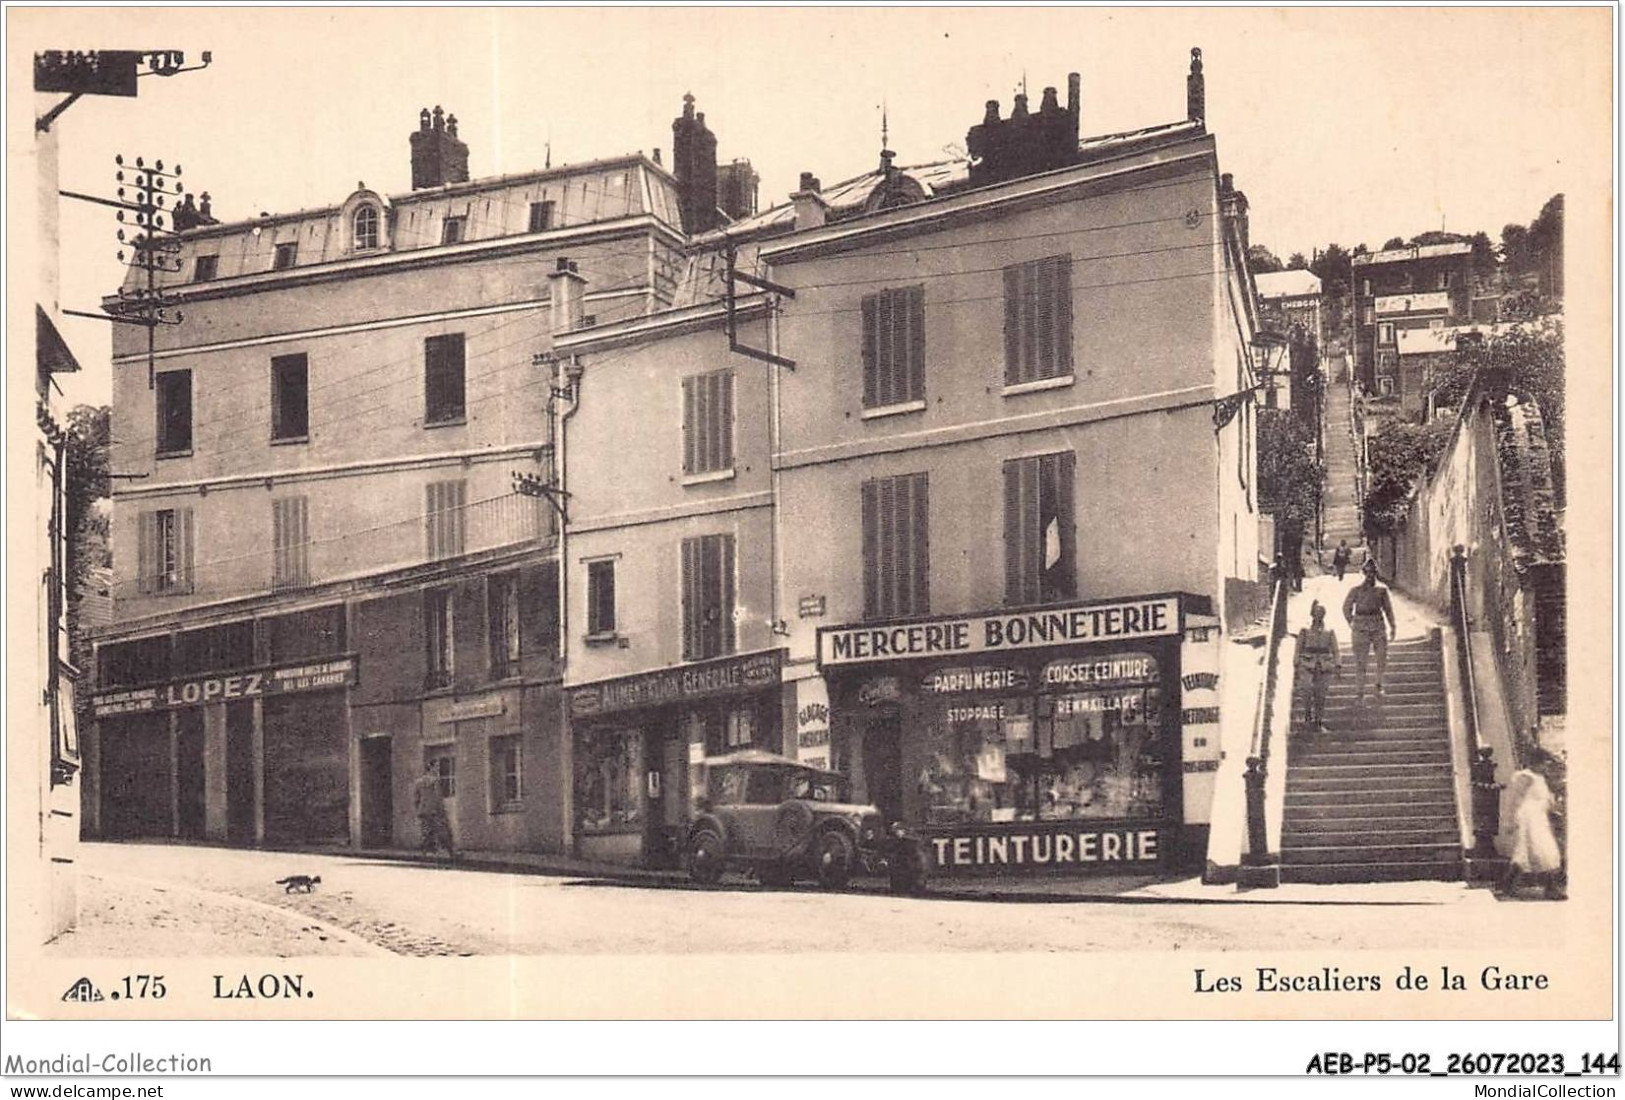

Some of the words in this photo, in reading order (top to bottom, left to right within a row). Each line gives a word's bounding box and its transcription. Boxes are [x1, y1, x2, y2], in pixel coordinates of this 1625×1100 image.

[832, 622, 970, 660] MERCERIE
[985, 604, 1167, 647] BONNETERIE
[167, 674, 262, 705] LOPEZ
[934, 671, 1015, 693] PARFUMERIE
[947, 706, 1005, 722] STOPPAGE
[932, 831, 1158, 865] TEINTURERIE
